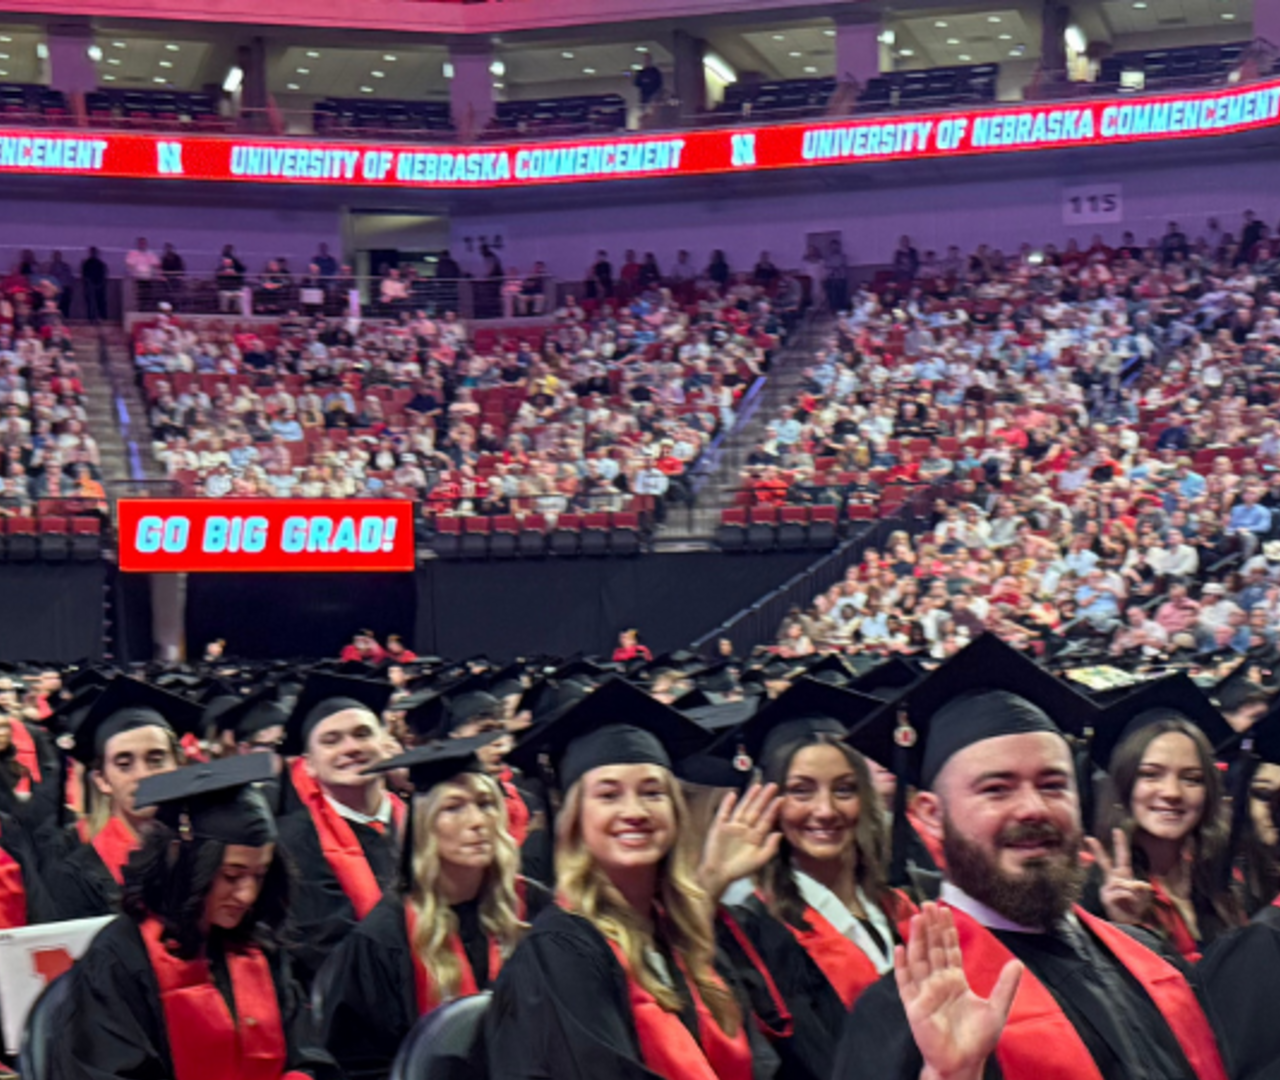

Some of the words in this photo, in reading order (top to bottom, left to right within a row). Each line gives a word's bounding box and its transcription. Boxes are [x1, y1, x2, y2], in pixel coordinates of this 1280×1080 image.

[731, 134, 756, 166] N
[802, 120, 933, 159] UNIVERSITY
[936, 118, 968, 149] OF
[971, 109, 1094, 146] NEBRASKA
[157, 141, 184, 174] N
[230, 145, 359, 179] UNIVERSITY
[363, 150, 393, 180] OF
[396, 151, 510, 183] NEBRASKA
[514, 140, 685, 179] COMMENCEMENT
[1069, 194, 1116, 213] 115
[135, 516, 191, 552] GO
[202, 516, 269, 552] BIG
[281, 516, 397, 552] GRAD!
